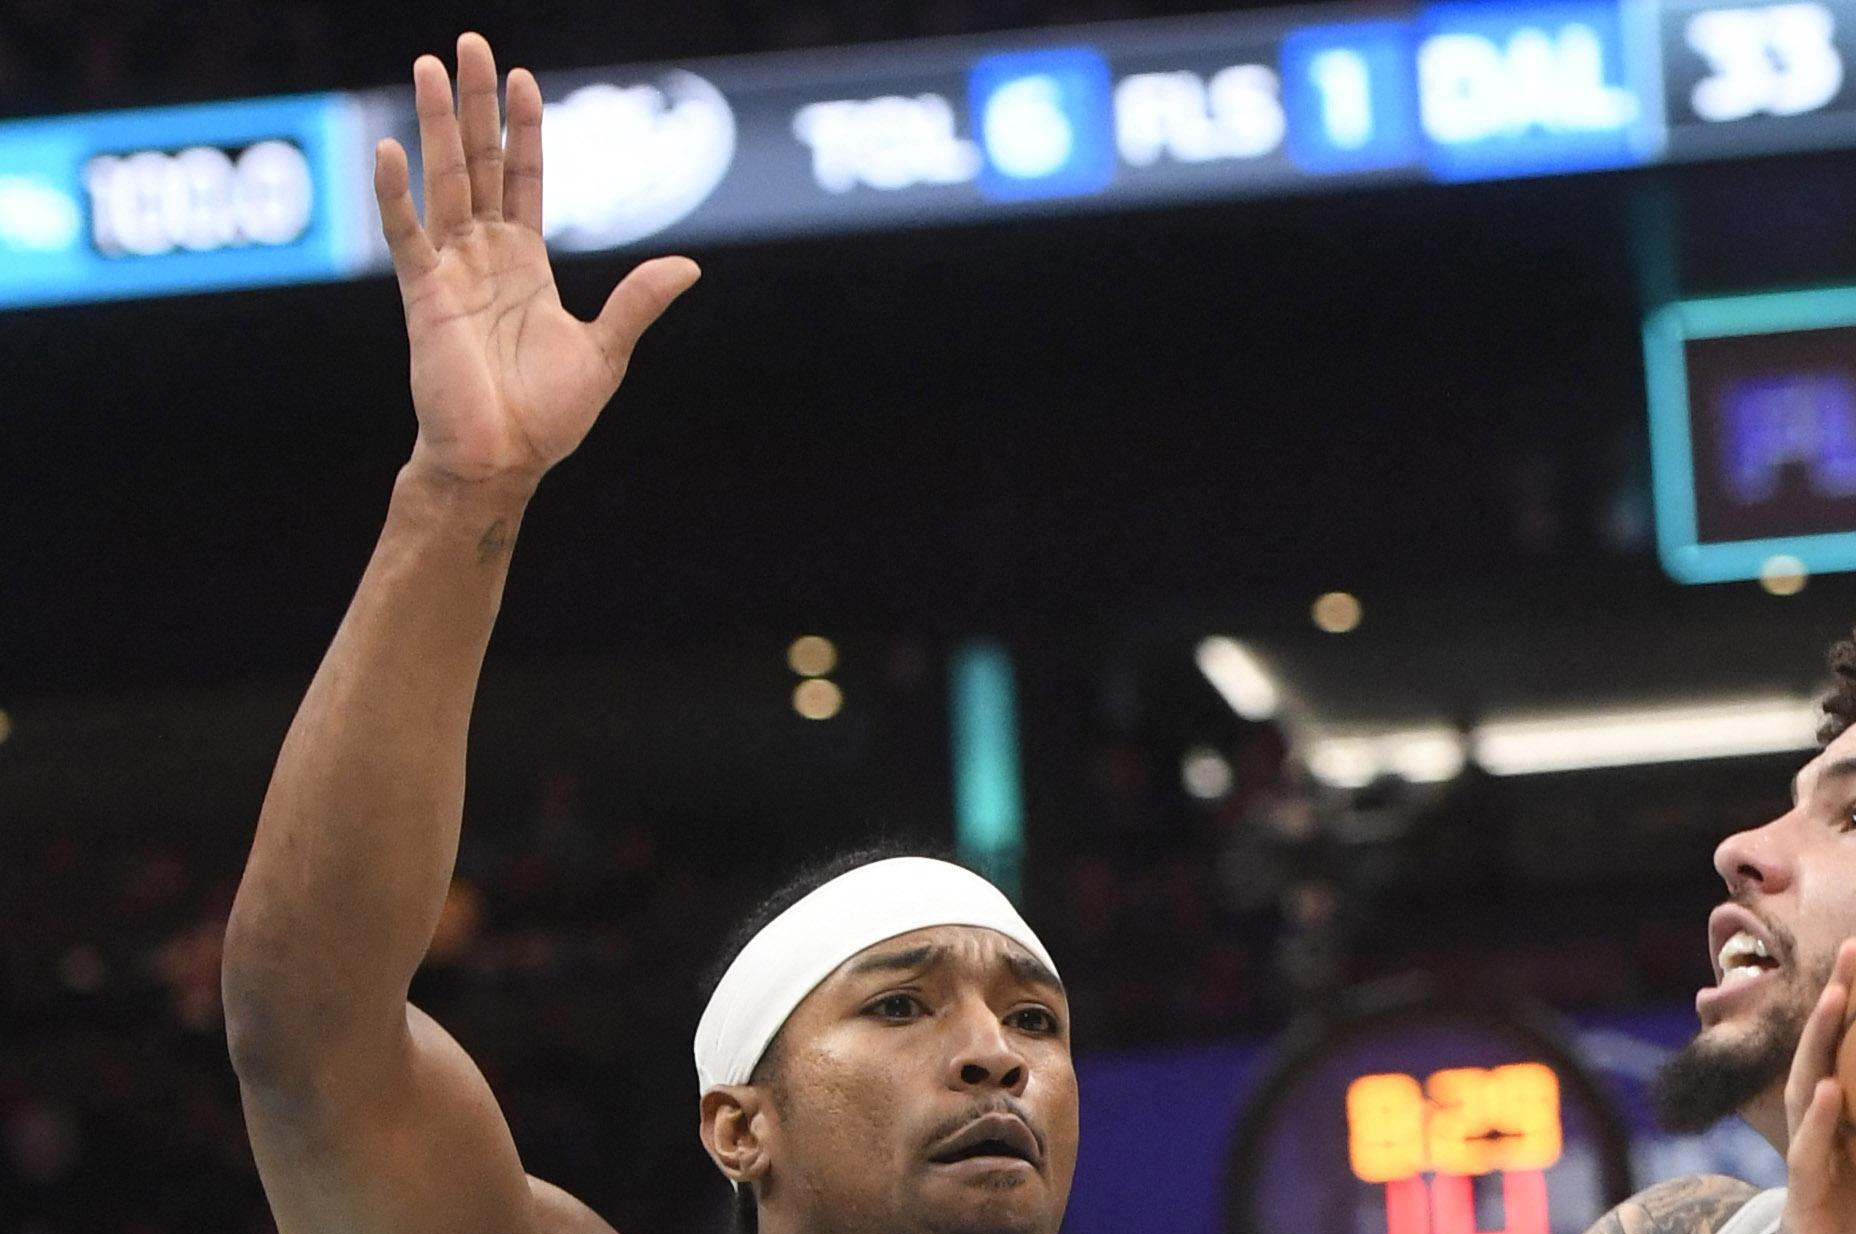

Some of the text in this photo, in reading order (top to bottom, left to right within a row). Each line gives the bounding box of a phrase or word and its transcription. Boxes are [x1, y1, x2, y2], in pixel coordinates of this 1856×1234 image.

[983, 75, 1073, 179] 6
[1310, 47, 1371, 149] 1
[1418, 24, 1640, 144] DAL
